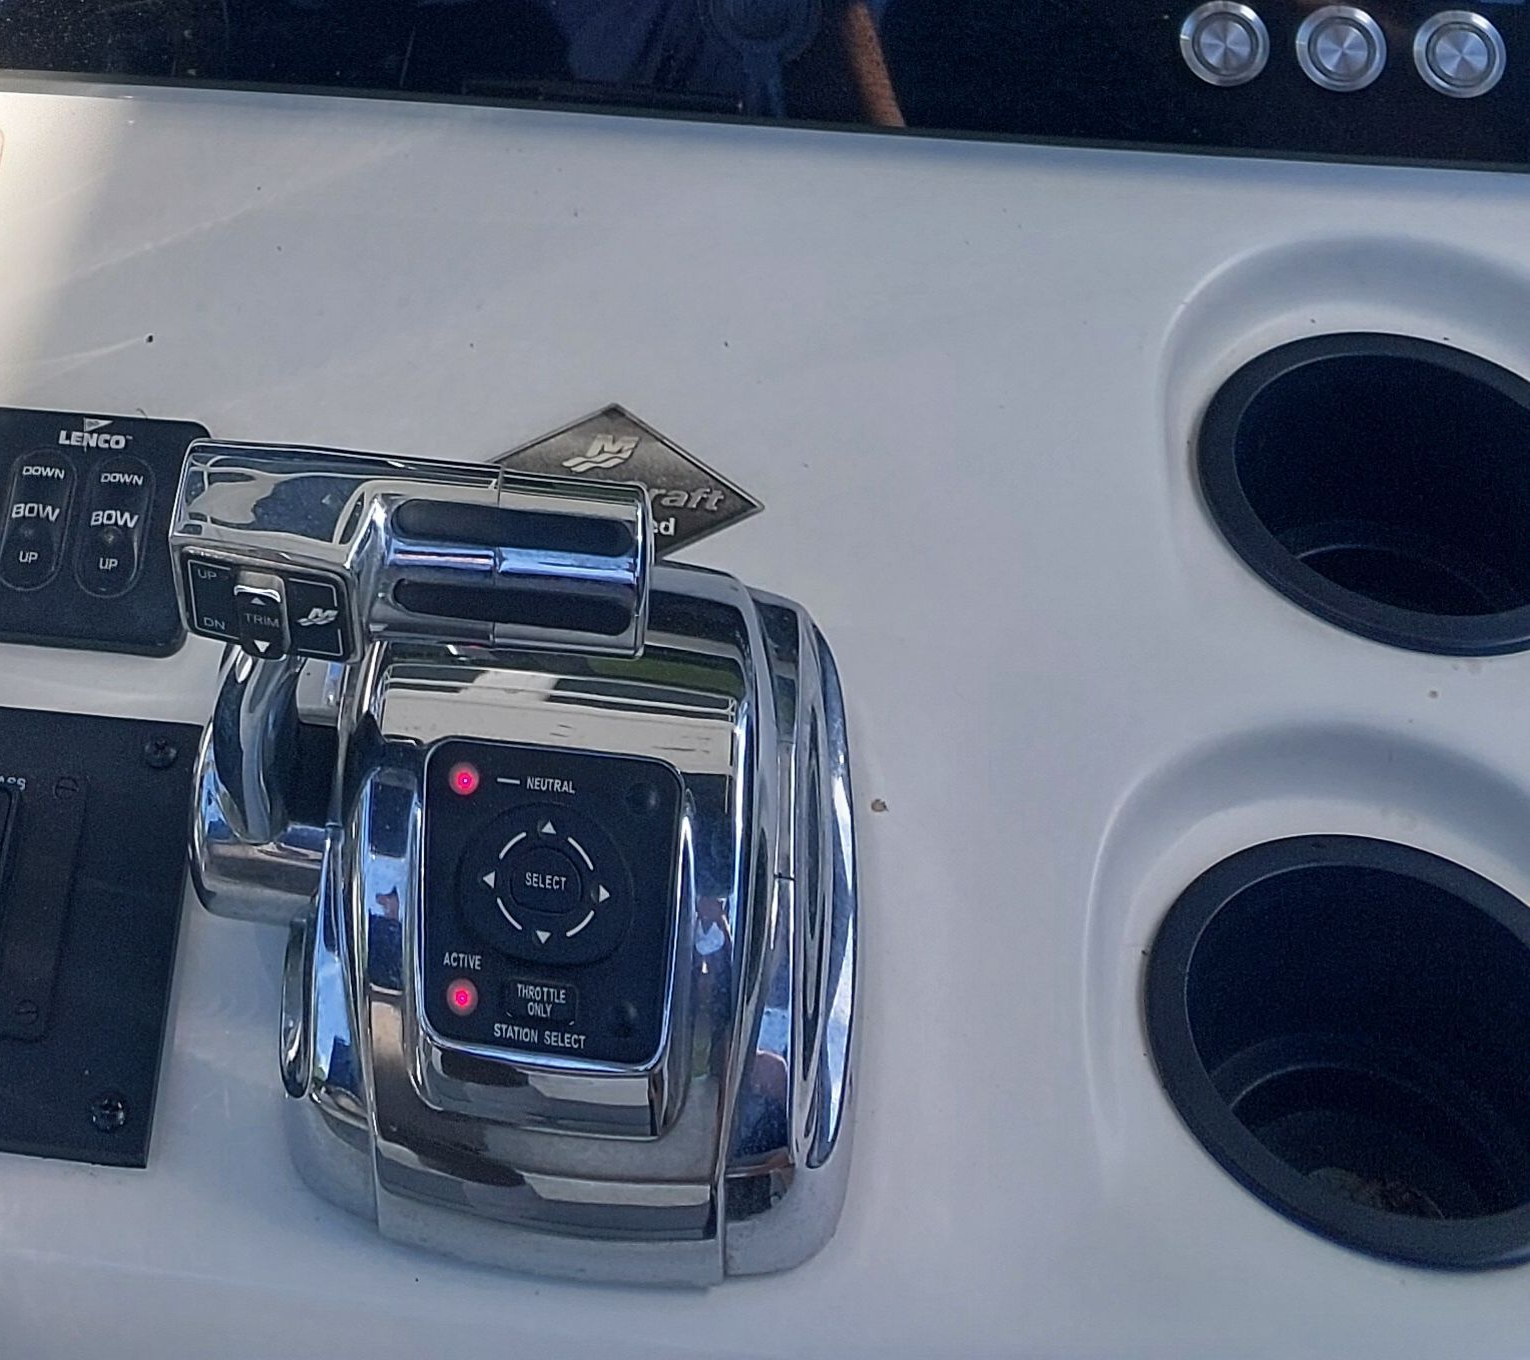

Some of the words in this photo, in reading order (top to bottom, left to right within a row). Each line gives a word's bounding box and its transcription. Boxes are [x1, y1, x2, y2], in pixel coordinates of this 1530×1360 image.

[58, 430, 126, 449] LENCO
[22, 465, 65, 479] DOWN
[100, 472, 144, 486] DOWN
[11, 503, 60, 522] BOW
[90, 510, 139, 529] BOW
[19, 551, 38, 563] UP
[99, 558, 118, 570] UP
[197, 568, 217, 579] UP
[203, 616, 226, 630] DN
[244, 613, 279, 628] TRIM
[526, 776, 576, 794] NEUTRAL
[525, 872, 567, 890] SELECT
[443, 952, 482, 970] ACTIVE
[517, 983, 567, 1004] THROTTLE
[527, 1002, 552, 1018] ONLY
[493, 1023, 538, 1043] STATION
[543, 1031, 586, 1049] SELECT
